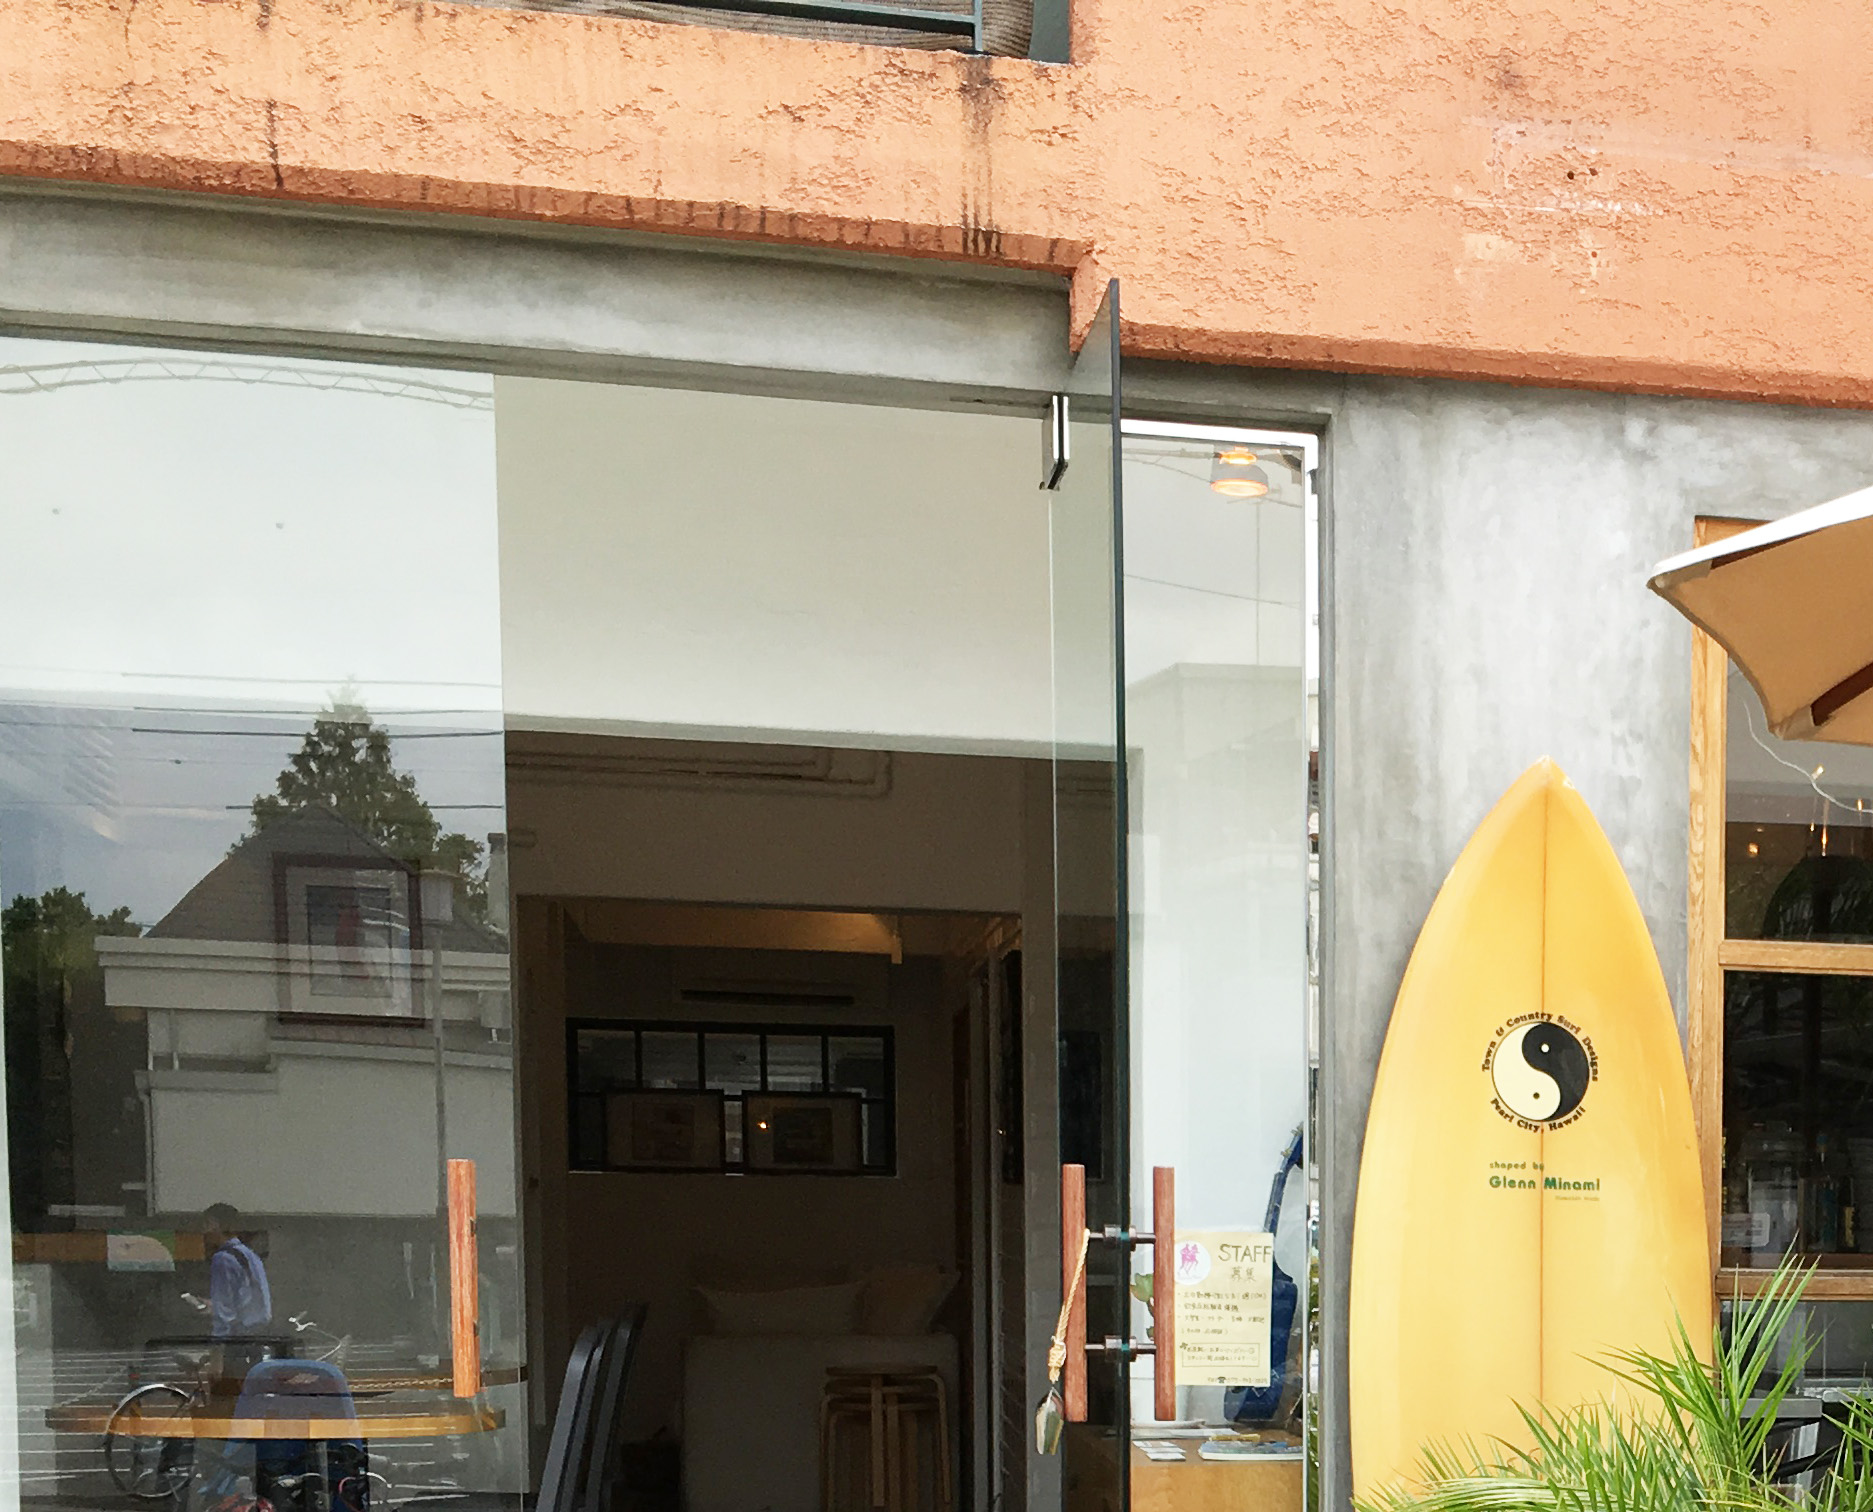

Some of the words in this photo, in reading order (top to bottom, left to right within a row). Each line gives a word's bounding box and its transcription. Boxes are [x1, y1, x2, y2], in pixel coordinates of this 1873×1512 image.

[1482, 1041, 1496, 1072] Town
[1506, 1011, 1553, 1028] Country
[1557, 1015, 1581, 1034] Surf
[1582, 1036, 1598, 1082] Designs
[1490, 1098, 1513, 1123] Pearl
[1549, 1106, 1586, 1131] Hawaii
[1489, 1161, 1527, 1170] shaped
[1533, 1162, 1544, 1171] by
[1489, 1176, 1536, 1189] Glenn
[1543, 1177, 1600, 1191] Minami
[1218, 1243, 1272, 1263] STAFF
